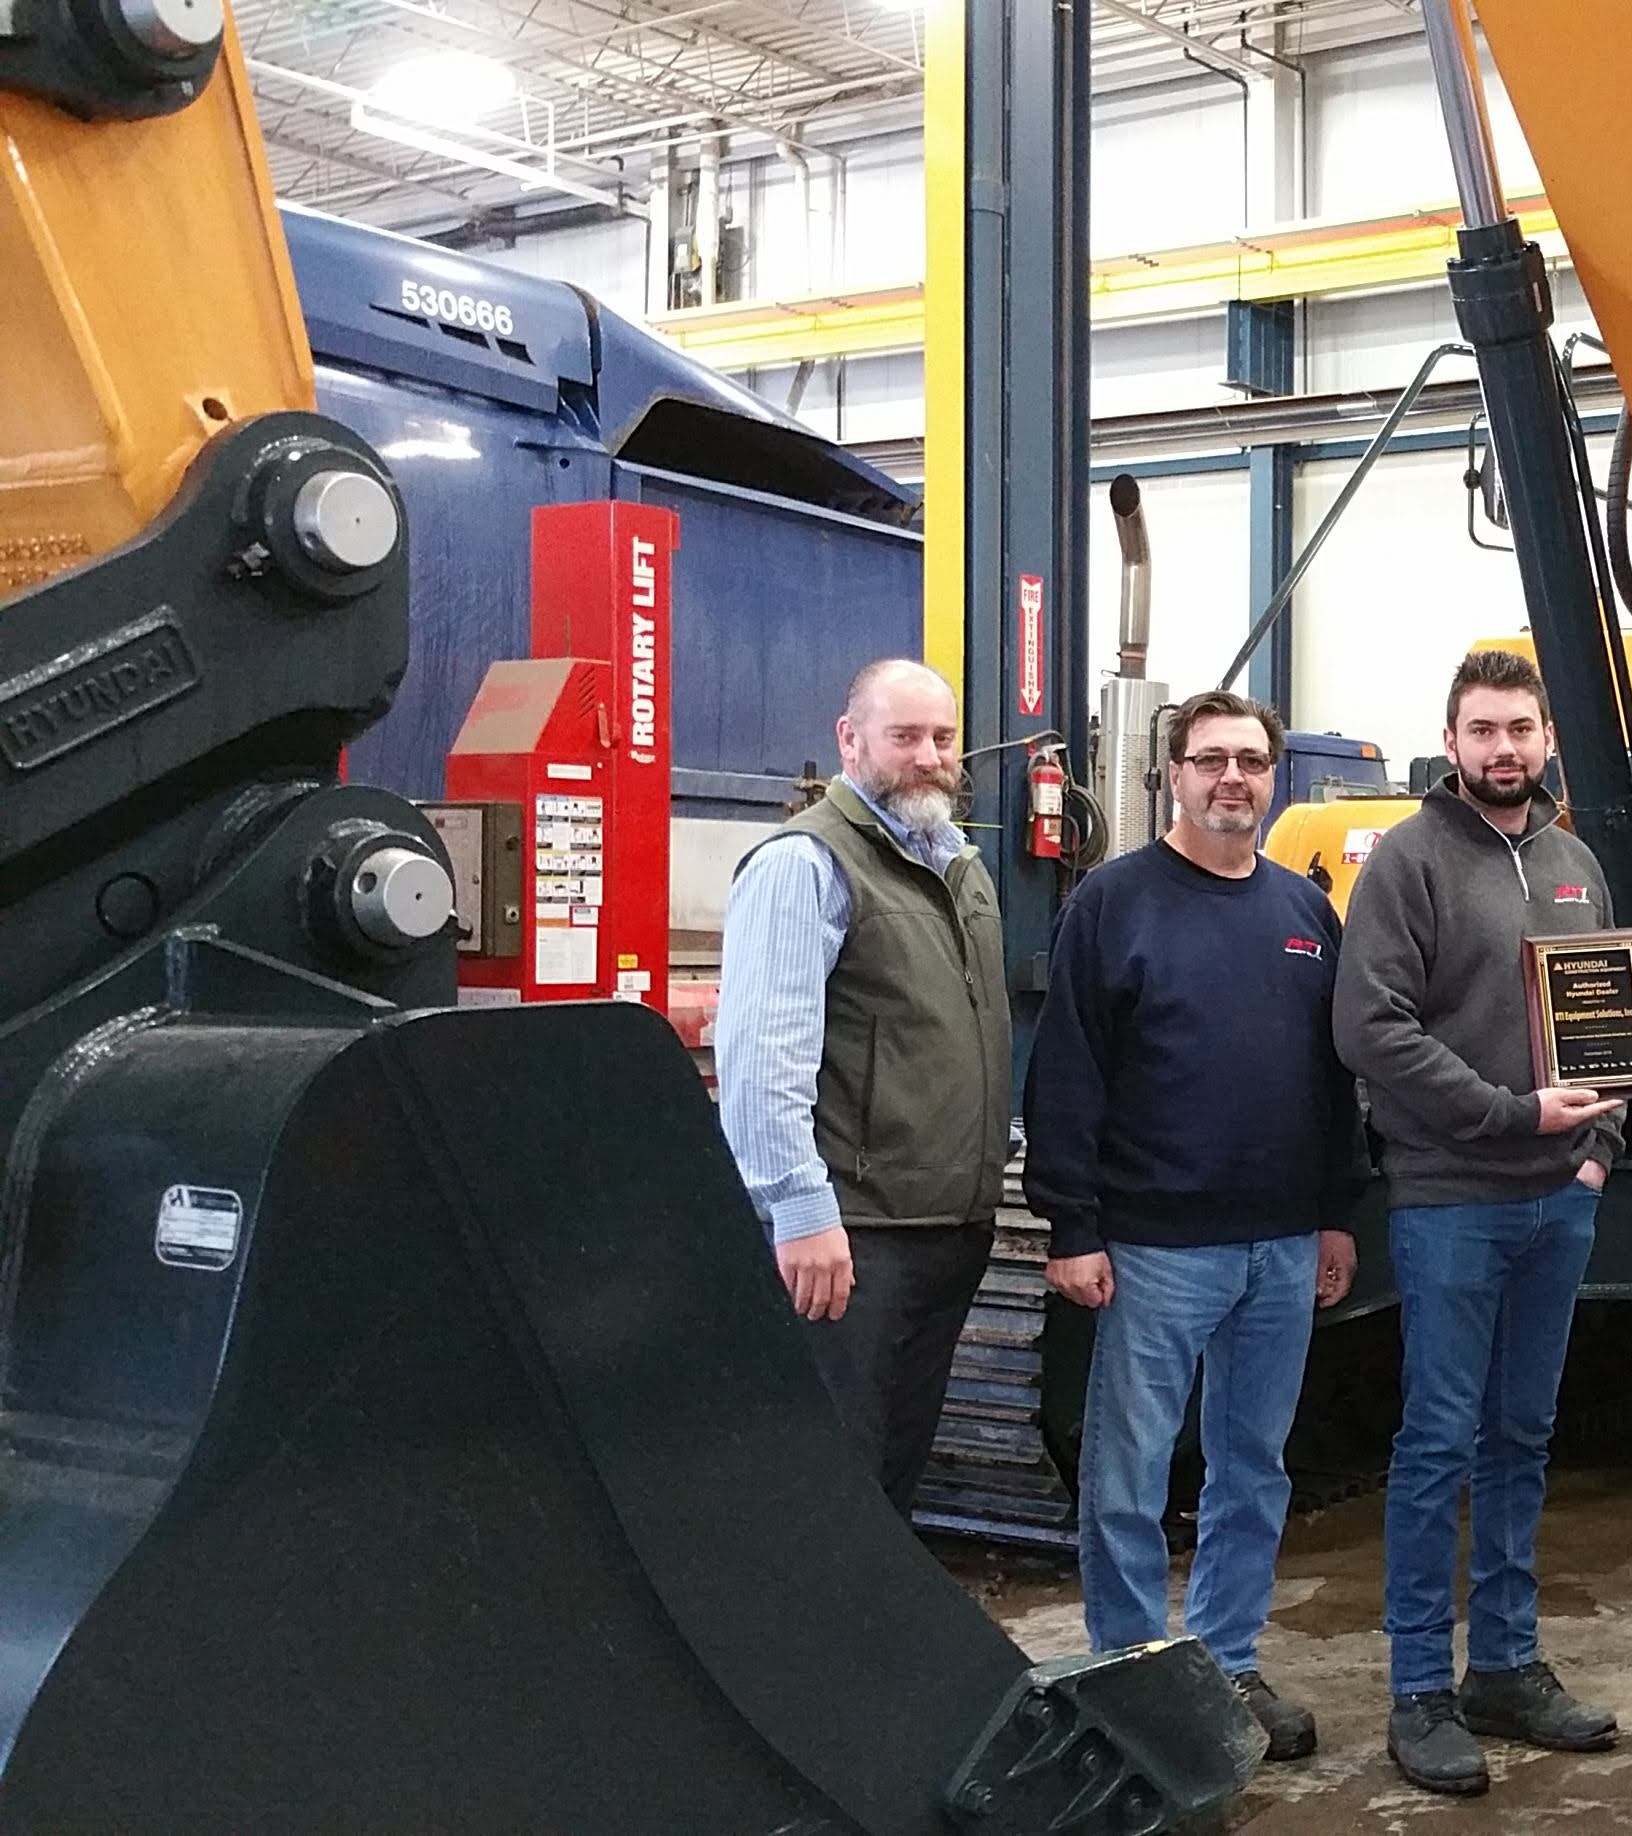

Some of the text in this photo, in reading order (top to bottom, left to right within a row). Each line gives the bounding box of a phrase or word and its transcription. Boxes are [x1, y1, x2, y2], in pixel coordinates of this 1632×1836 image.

[402, 279, 514, 336] 530666
[633, 536, 655, 607] LIFT
[1023, 588, 1039, 603] FIRE
[1027, 607, 1036, 703] EXTINGUISHER
[5, 638, 184, 749] HYUNDAI
[632, 611, 655, 746] ROTARY
[1564, 960, 1608, 970] HYUNDAI
[1566, 988, 1619, 999] Hyundai Dealer
[1573, 980, 1611, 989] Authorized
[1565, 1011, 1595, 1022] Equipment
